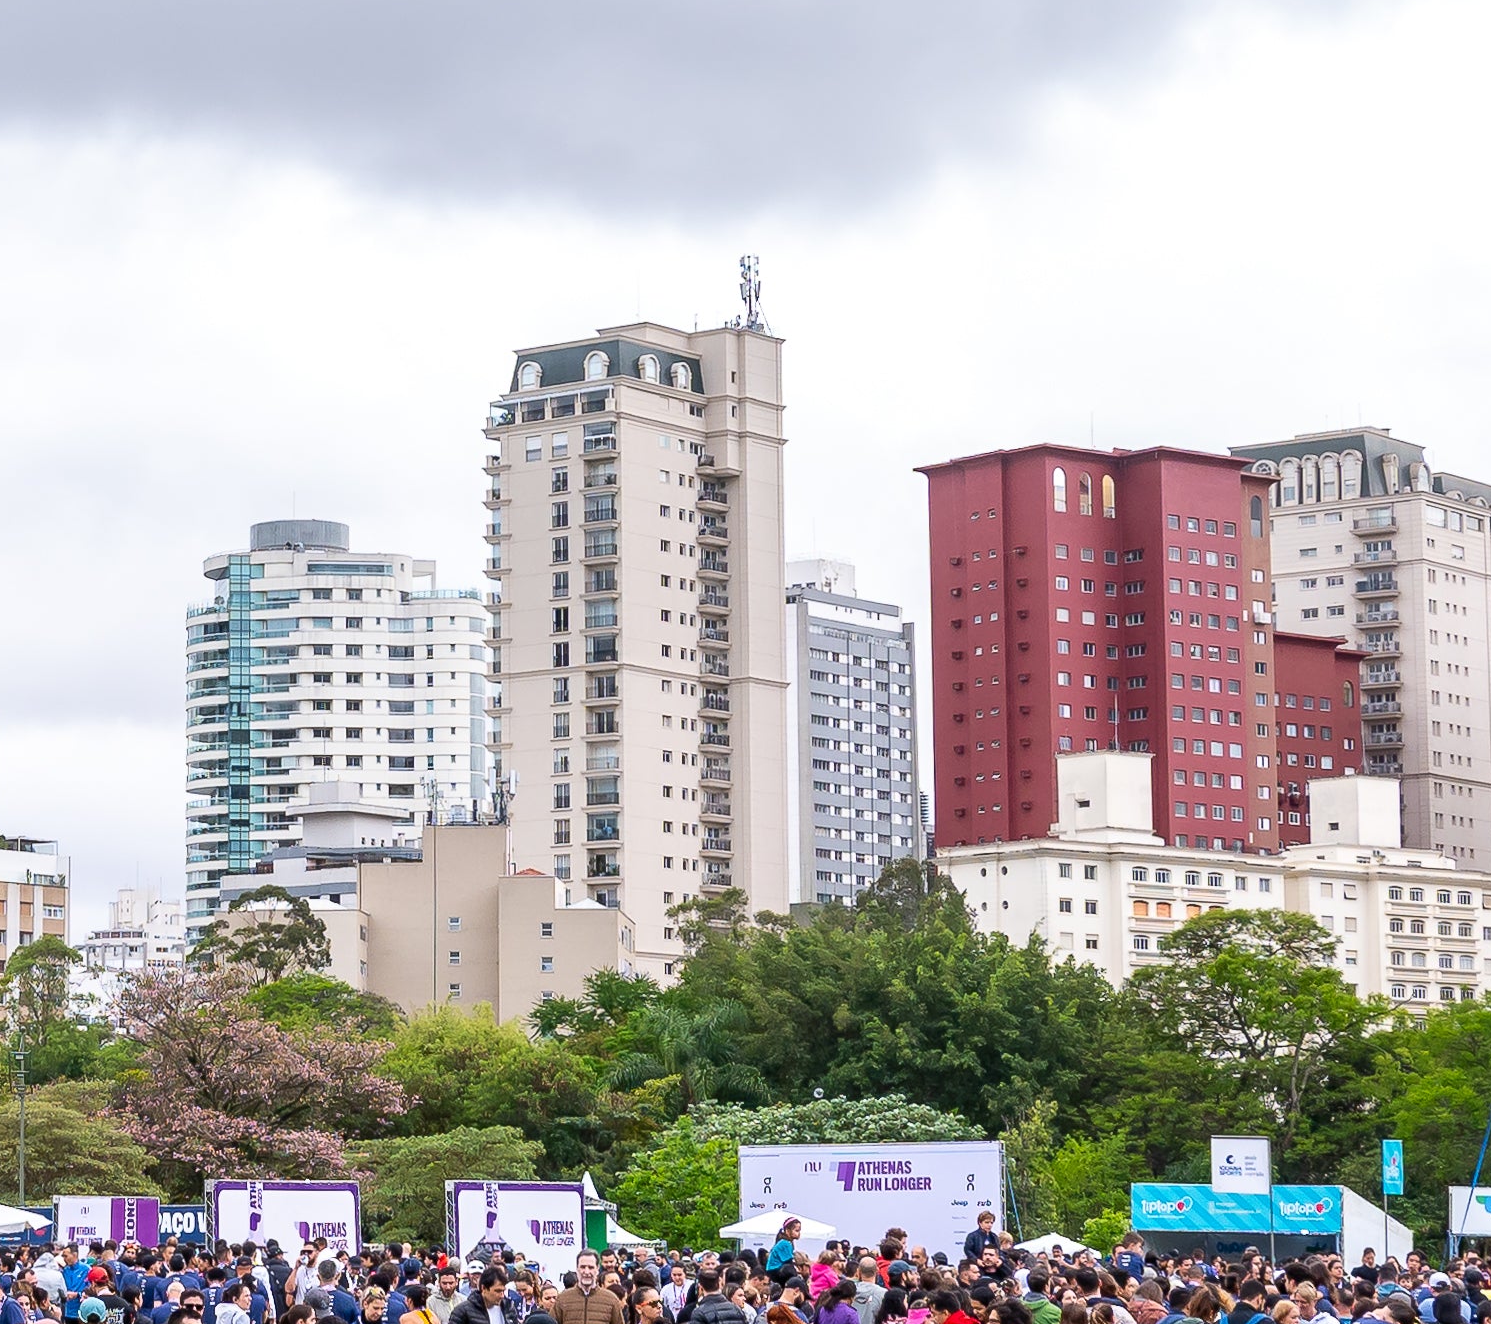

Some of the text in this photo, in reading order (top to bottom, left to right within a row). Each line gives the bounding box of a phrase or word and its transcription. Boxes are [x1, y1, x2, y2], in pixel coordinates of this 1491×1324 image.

[858, 1161, 912, 1175] ATHENAS
[857, 1177, 932, 1191] RUN LONGER
[1141, 1199, 1177, 1214] tiptop
[1278, 1201, 1314, 1217] tiptop
[312, 1222, 347, 1238] ATHENAS
[542, 1221, 574, 1235] ATHENAS
